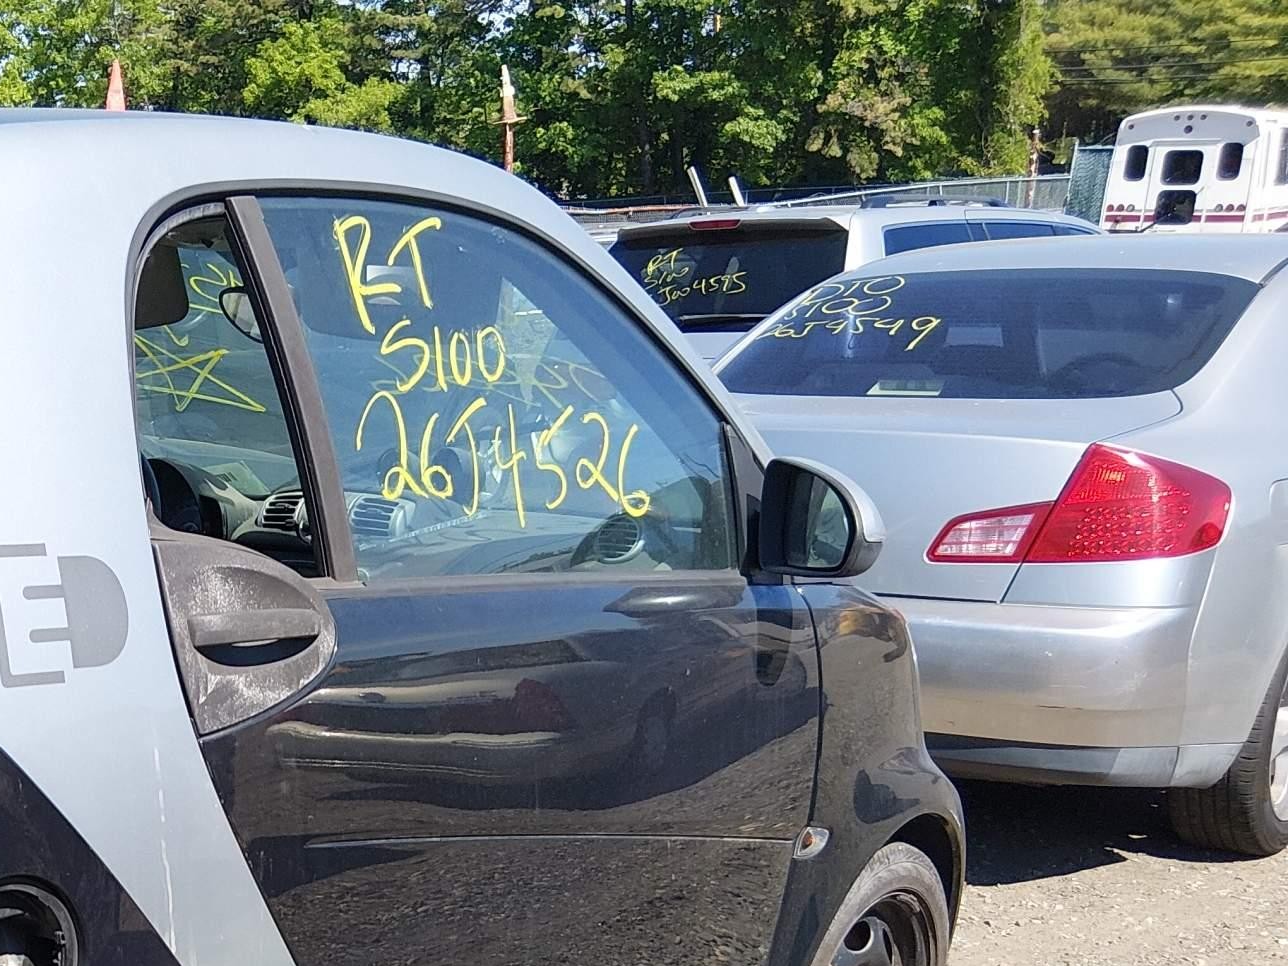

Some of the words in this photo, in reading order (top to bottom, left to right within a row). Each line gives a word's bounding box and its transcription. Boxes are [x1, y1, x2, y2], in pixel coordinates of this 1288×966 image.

[333, 214, 442, 335] RT
[380, 318, 506, 393] S100
[356, 390, 652, 529] 26J4526
